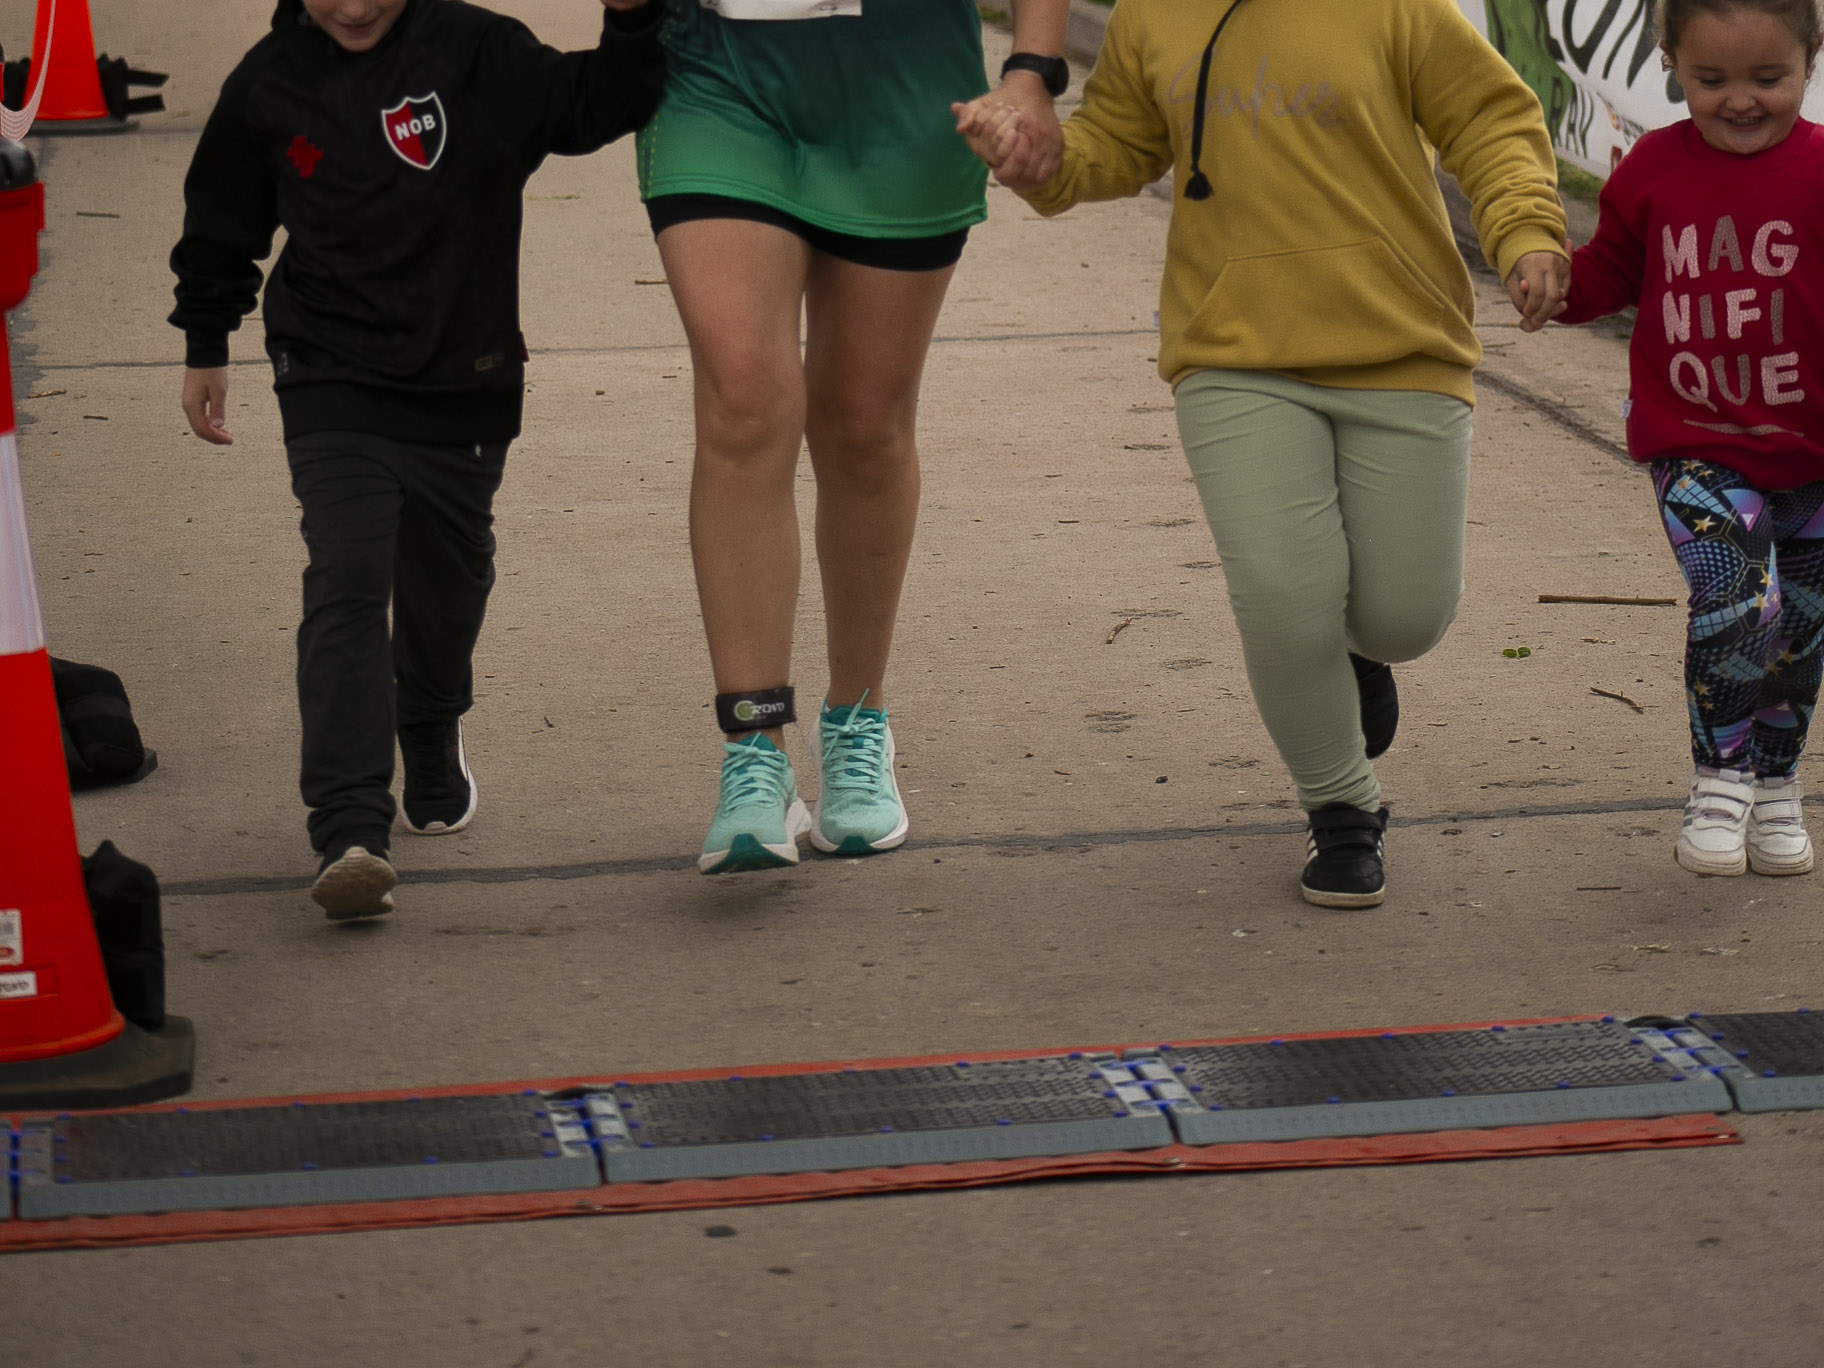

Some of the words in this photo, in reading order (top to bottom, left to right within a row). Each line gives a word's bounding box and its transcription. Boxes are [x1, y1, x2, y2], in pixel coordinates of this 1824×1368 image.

[395, 114, 436, 140] NOB
[1662, 215, 1799, 283] MAG
[1662, 288, 1784, 345] NIFI
[1669, 351, 1805, 413] QUE
